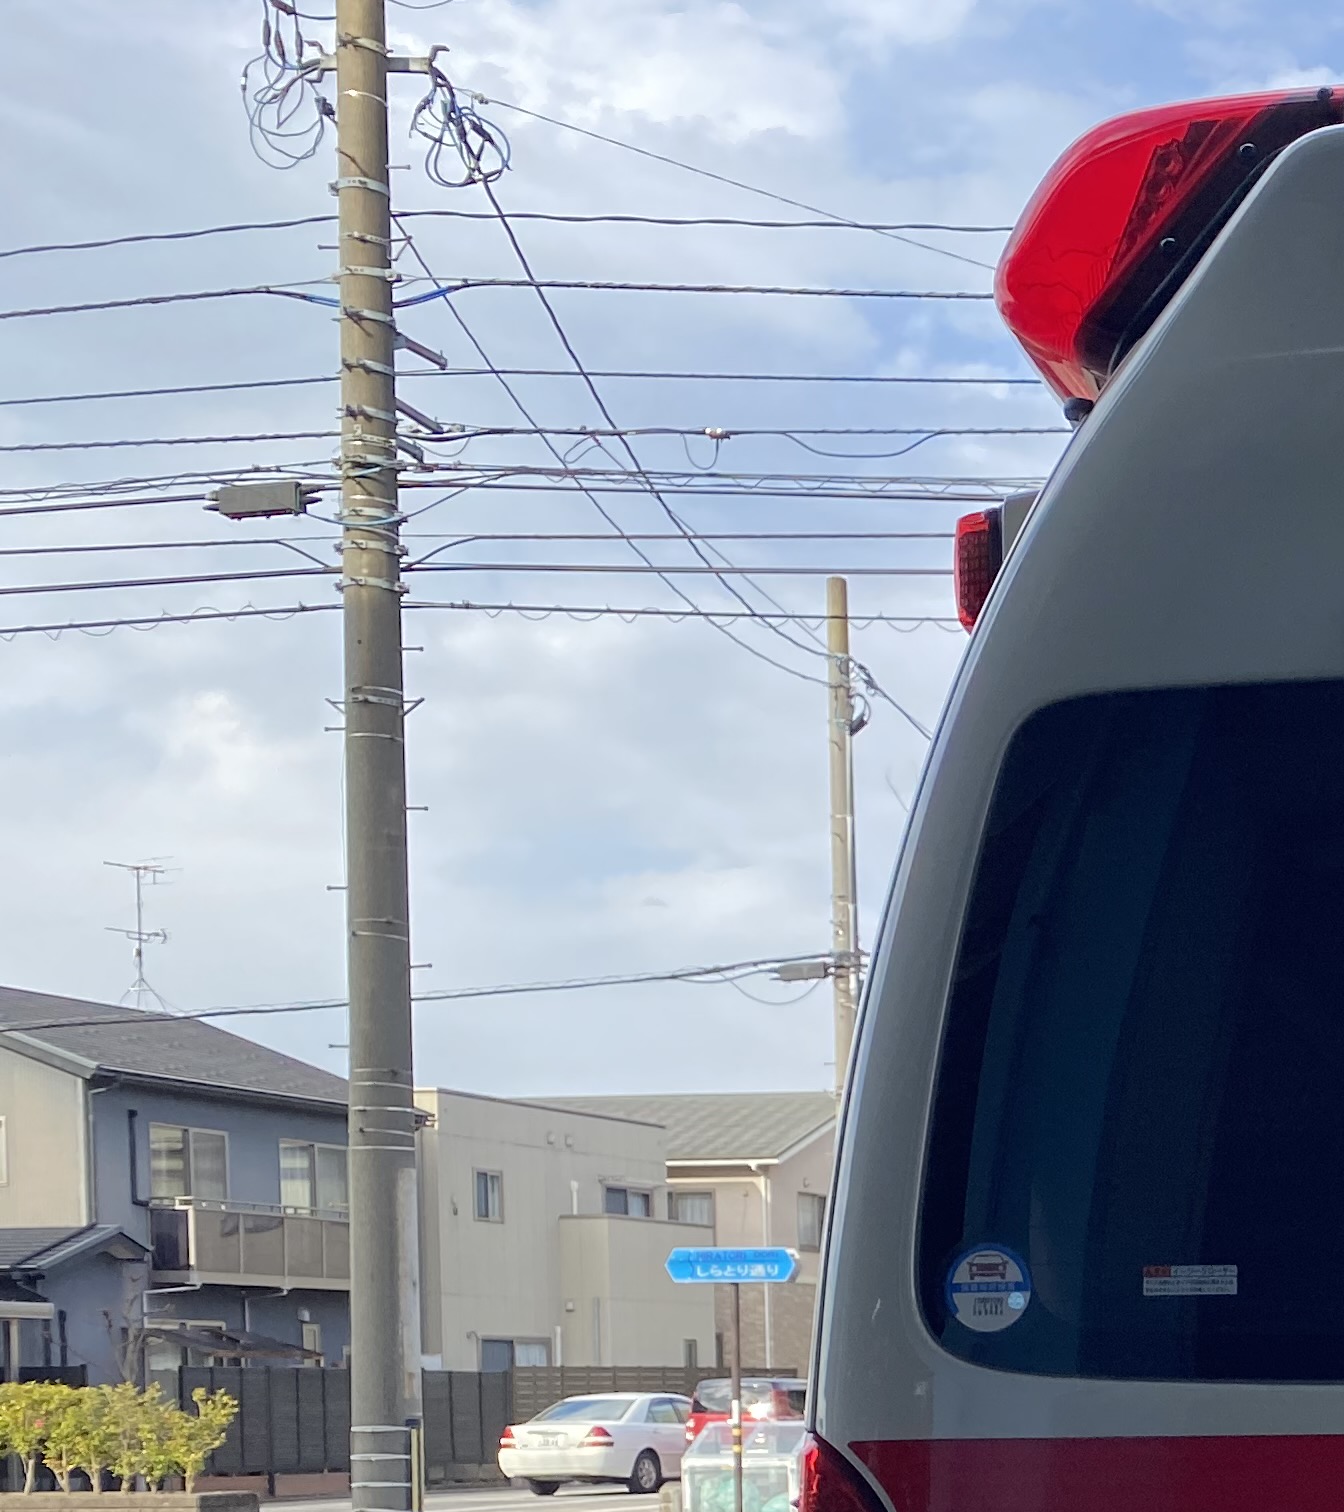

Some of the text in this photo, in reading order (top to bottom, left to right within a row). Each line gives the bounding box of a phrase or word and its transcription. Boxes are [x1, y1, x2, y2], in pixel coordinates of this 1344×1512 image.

[696, 1263, 779, 1278] しらとり通り
